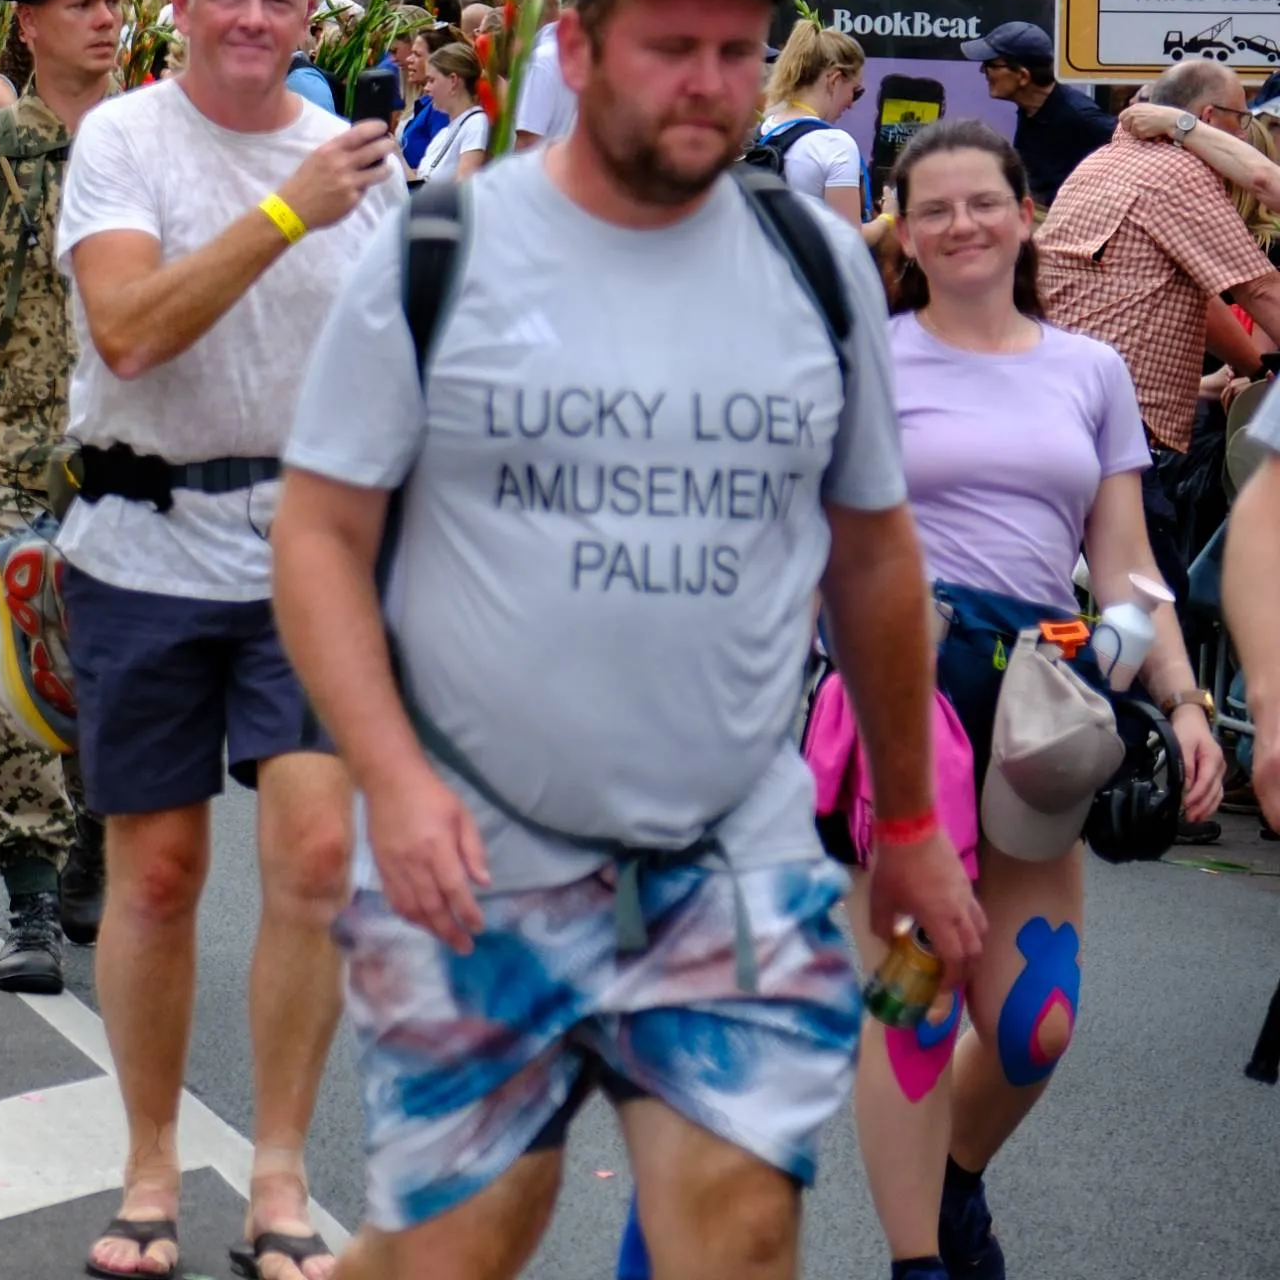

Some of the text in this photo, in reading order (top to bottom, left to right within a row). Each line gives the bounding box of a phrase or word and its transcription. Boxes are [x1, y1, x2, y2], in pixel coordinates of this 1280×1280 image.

[833, 8, 981, 39] BookBeat
[485, 387, 816, 449] LUCKY LOEK
[494, 463, 805, 522] AMUSEMENT
[570, 539, 741, 597] PALIJS
